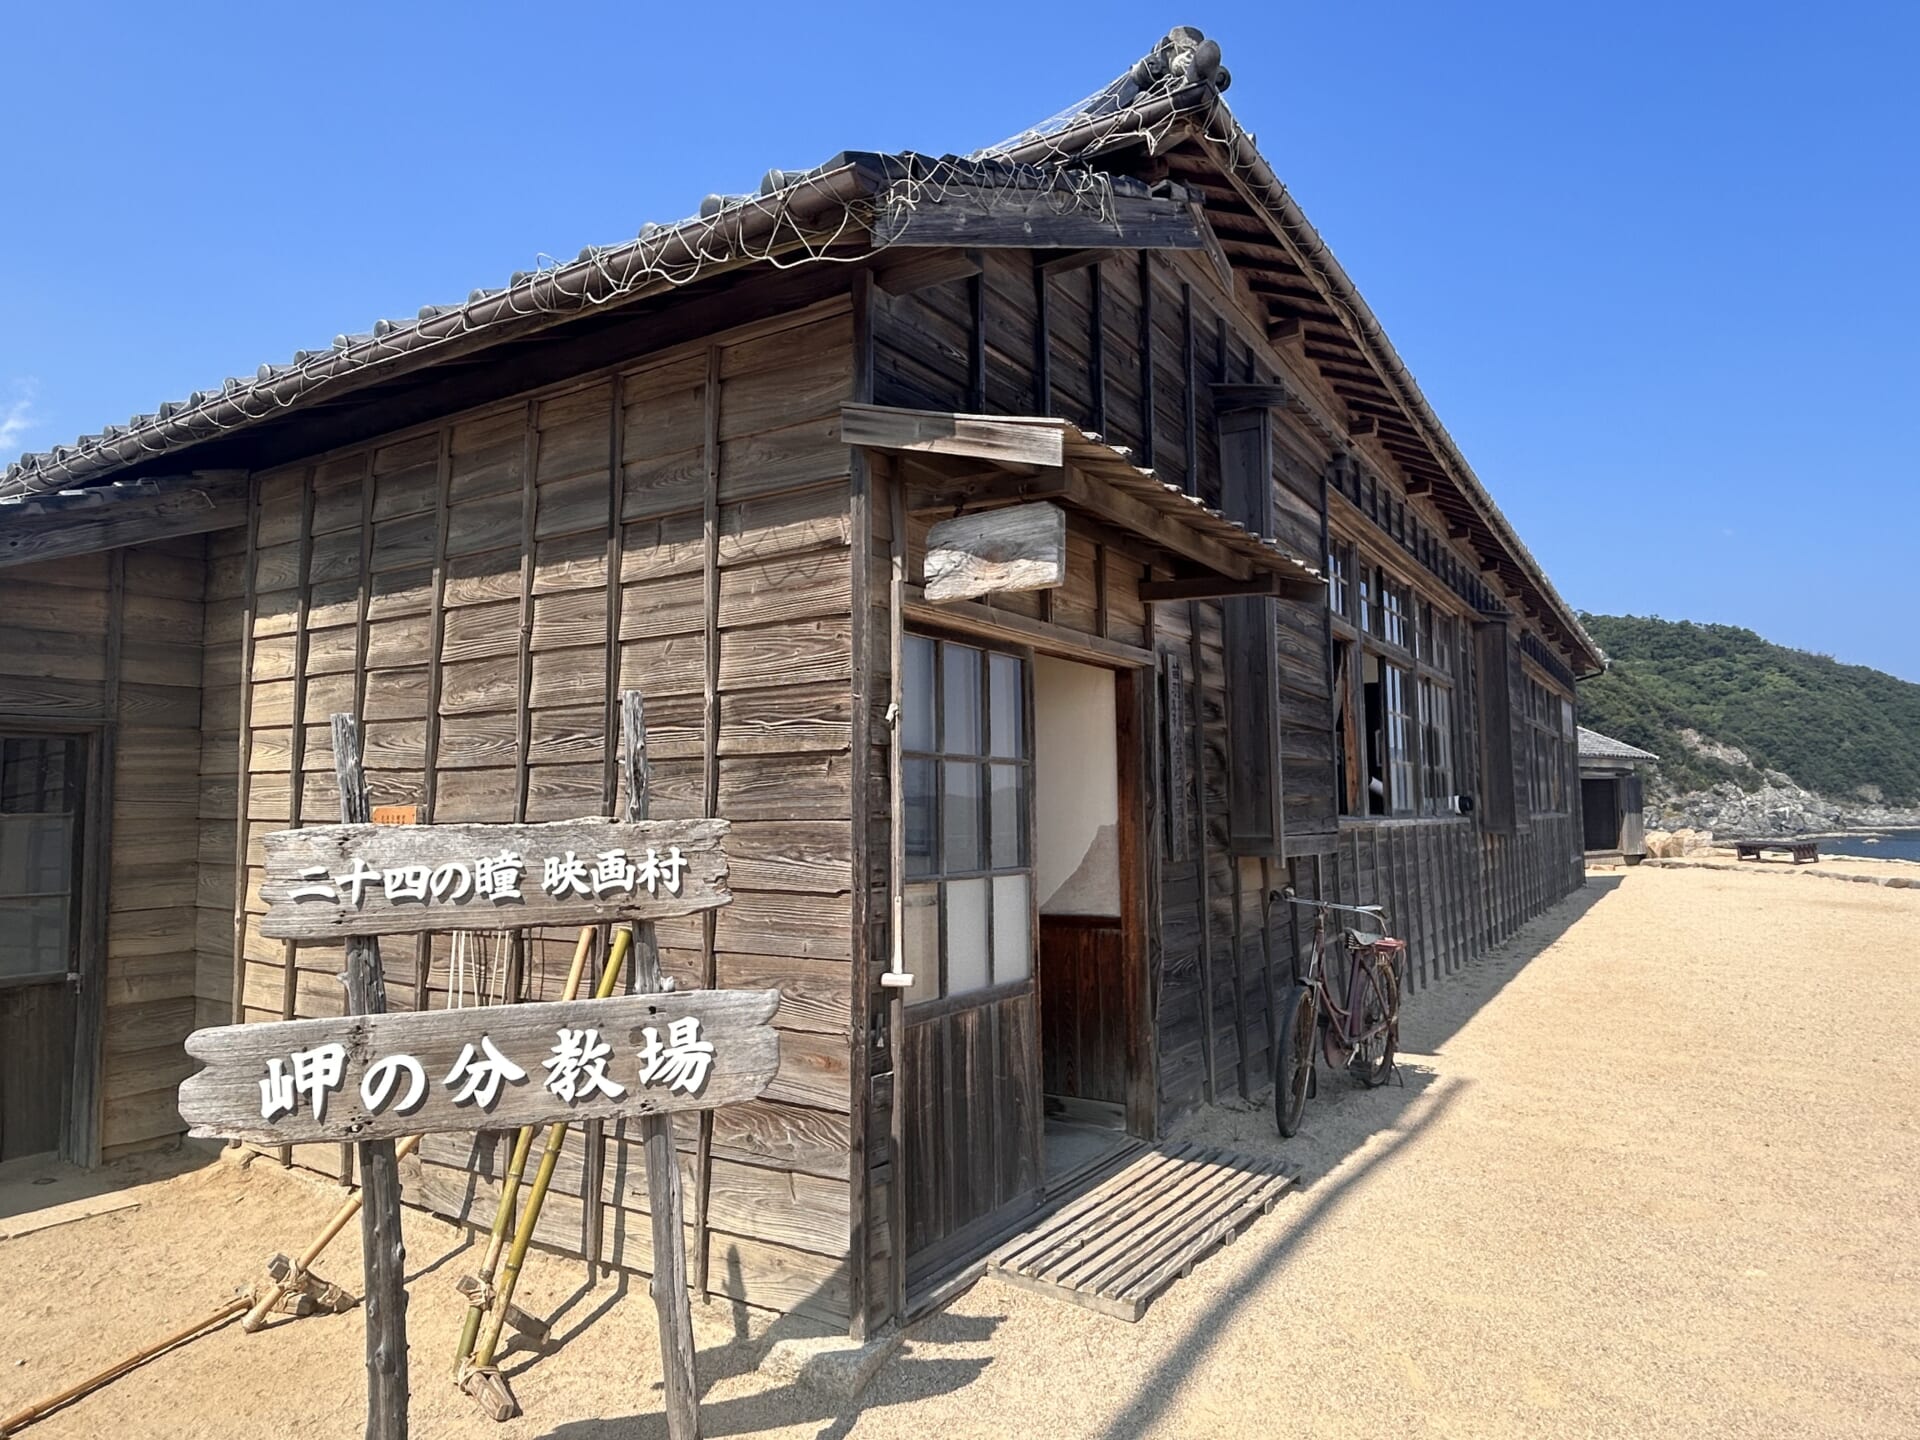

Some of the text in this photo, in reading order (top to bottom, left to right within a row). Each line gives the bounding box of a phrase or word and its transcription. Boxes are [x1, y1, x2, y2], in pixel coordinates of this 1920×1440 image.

[287, 847, 688, 905] 二十四の瞳 映画村
[259, 1016, 715, 1120] 岬の分教場
